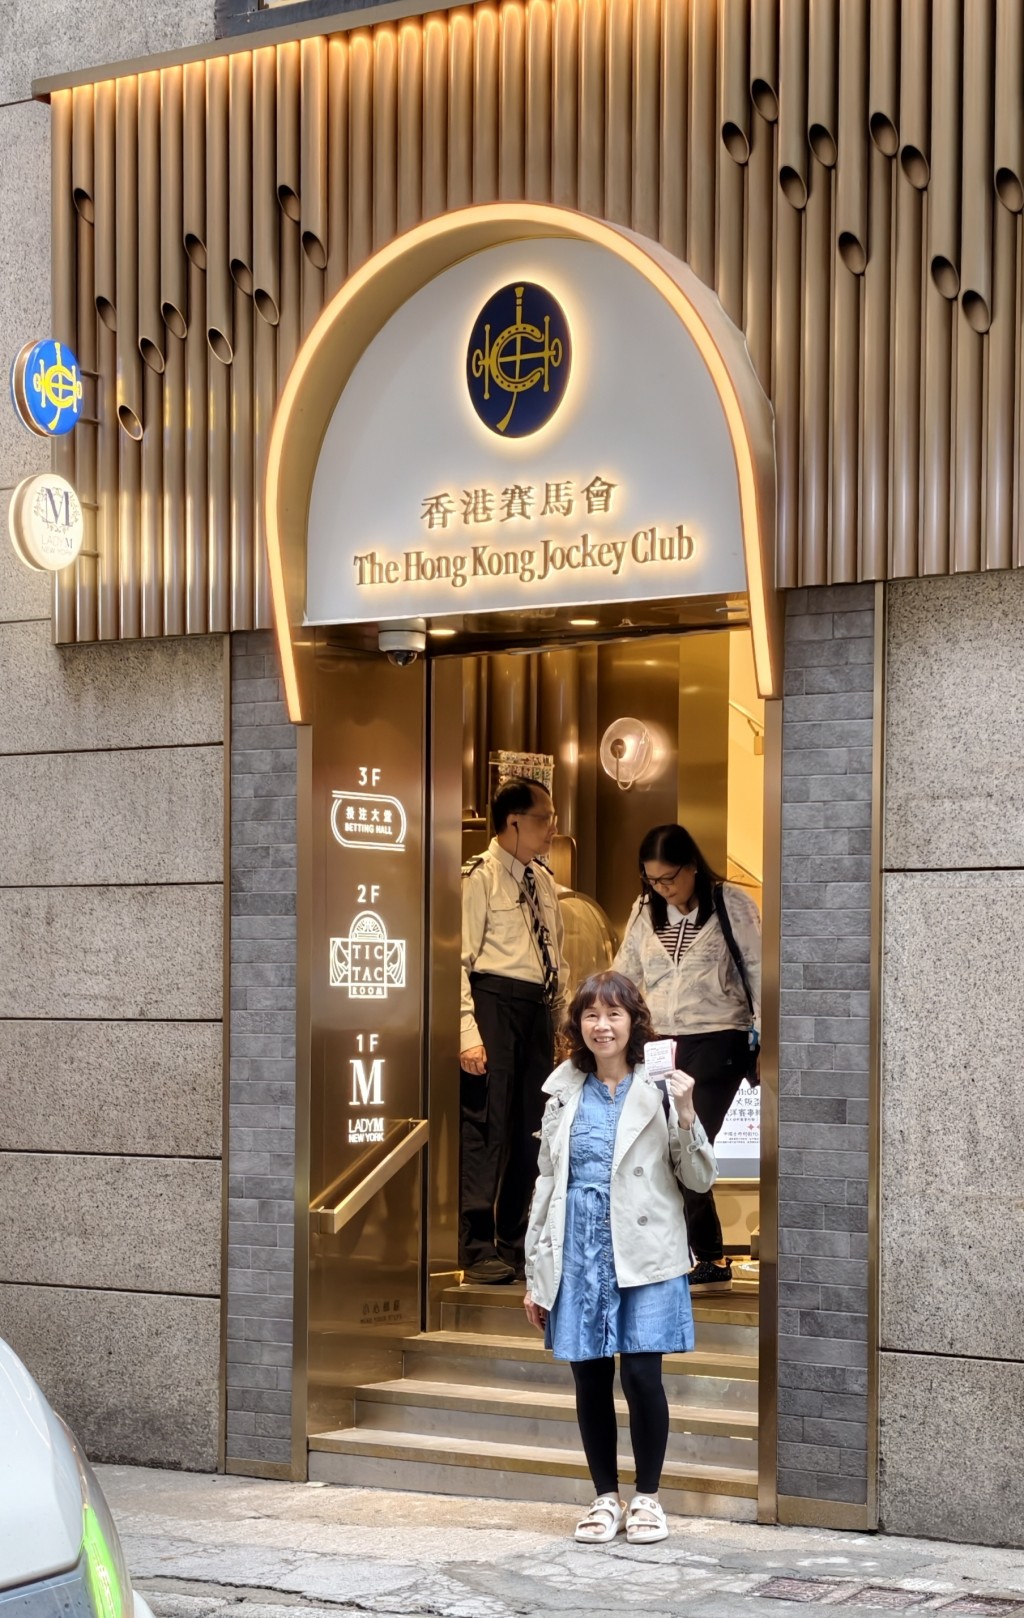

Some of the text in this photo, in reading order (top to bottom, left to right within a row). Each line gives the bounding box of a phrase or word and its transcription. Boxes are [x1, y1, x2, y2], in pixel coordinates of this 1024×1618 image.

[41, 486, 73, 527] M
[421, 476, 618, 529] 香港賽馬會
[353, 525, 695, 587] The Hong Kong Jockey Club
[358, 767, 381, 786] 3F
[344, 823, 392, 834] BETTING HALL
[357, 884, 380, 903] 2F
[352, 945, 383, 959] TIC
[352, 967, 383, 981] TAC
[352, 986, 383, 995] ROOM
[356, 1034, 379, 1052] 1F
[349, 1059, 385, 1105] M
[349, 1133, 384, 1143] NEW YORK
